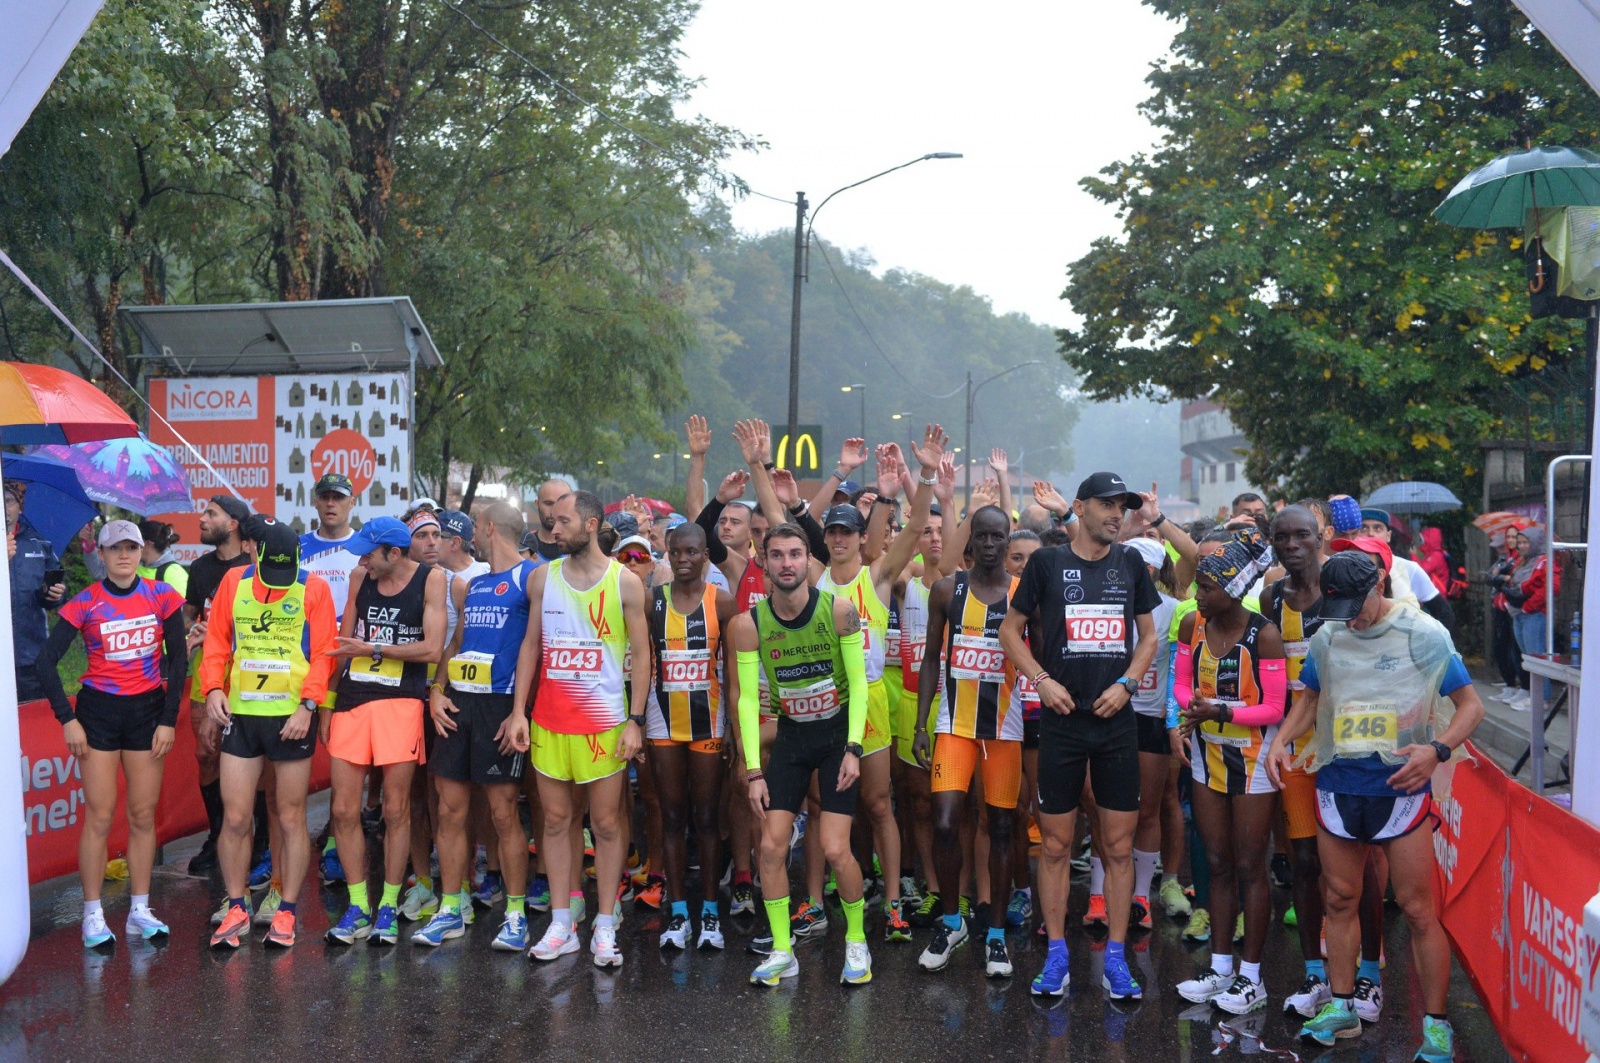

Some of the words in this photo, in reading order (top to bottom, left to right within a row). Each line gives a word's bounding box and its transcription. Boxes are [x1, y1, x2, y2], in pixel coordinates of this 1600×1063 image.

[186, 467, 269, 488] ARDINAGGIO
[84, 486, 119, 503] London
[173, 549, 200, 561] ORA
[367, 606, 401, 622] EA7
[473, 605, 510, 613] SPORT
[464, 611, 509, 629] ommy
[1070, 619, 1122, 639] 1090
[106, 627, 156, 651] 1046
[783, 642, 831, 657] MERCURIO
[549, 650, 598, 669] 1043
[955, 648, 1005, 670] 1003
[460, 663, 477, 681] 10
[666, 662, 708, 680] 1001
[777, 665, 809, 679] ARREDO
[810, 662, 834, 674] JOLLY
[256, 674, 269, 690] 7
[785, 693, 835, 714] 1002
[1341, 716, 1388, 739] 246
[1519, 939, 1586, 1046] CITYRU
